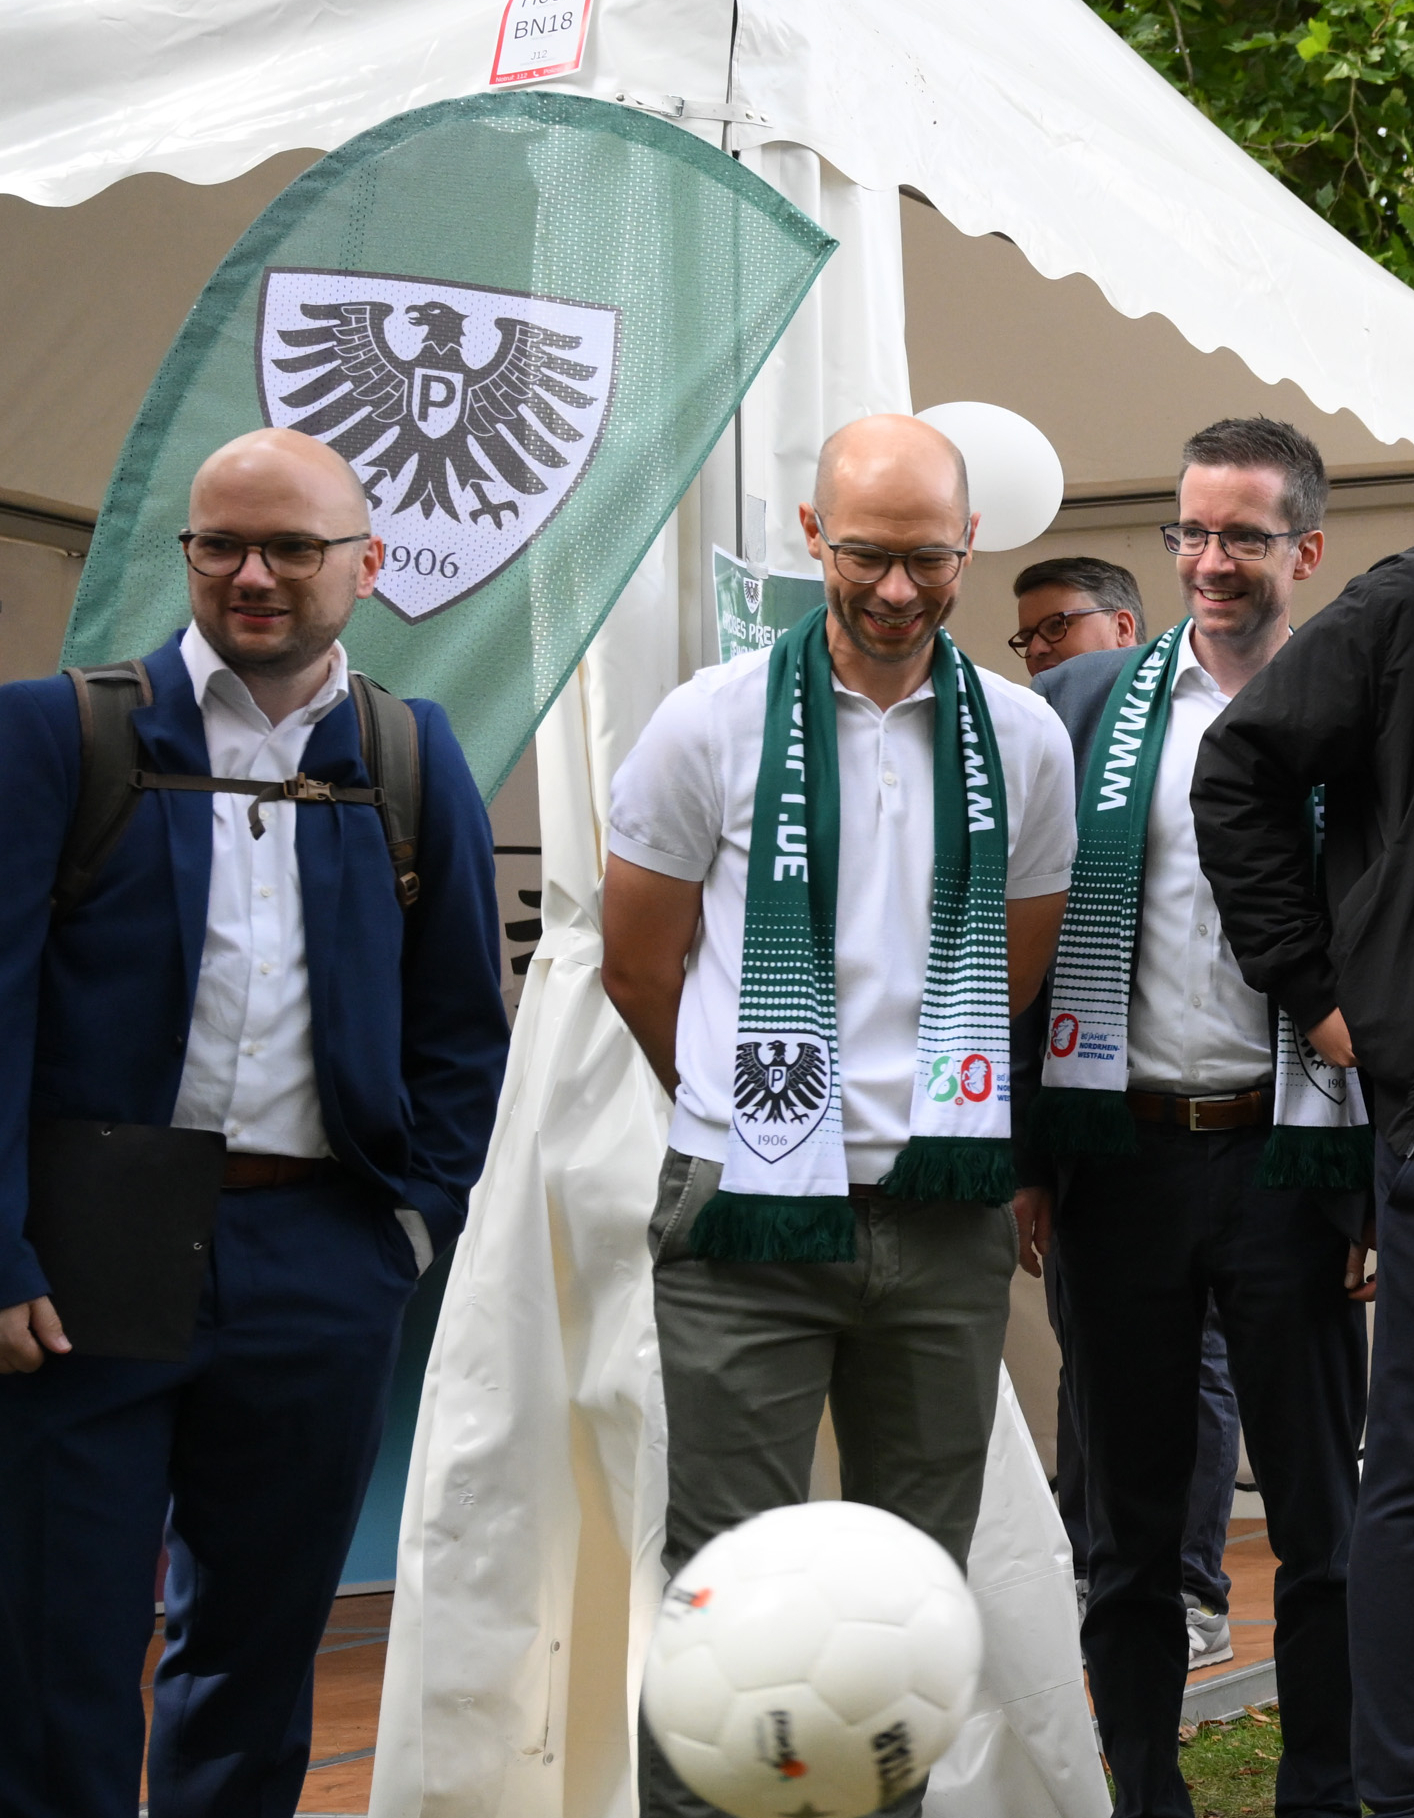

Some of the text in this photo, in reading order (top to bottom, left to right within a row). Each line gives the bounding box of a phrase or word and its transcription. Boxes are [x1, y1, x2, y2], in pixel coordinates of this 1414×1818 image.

[514, 11, 573, 39] BN18
[530, 49, 548, 60] J12
[417, 374, 456, 423] P
[380, 543, 460, 579] 1906
[1079, 1042, 1121, 1052] NORDRHEIN-
[1078, 1052, 1115, 1061] WESTFALEN
[1328, 1078, 1346, 1089] 190
[758, 1134, 788, 1146] 1906
